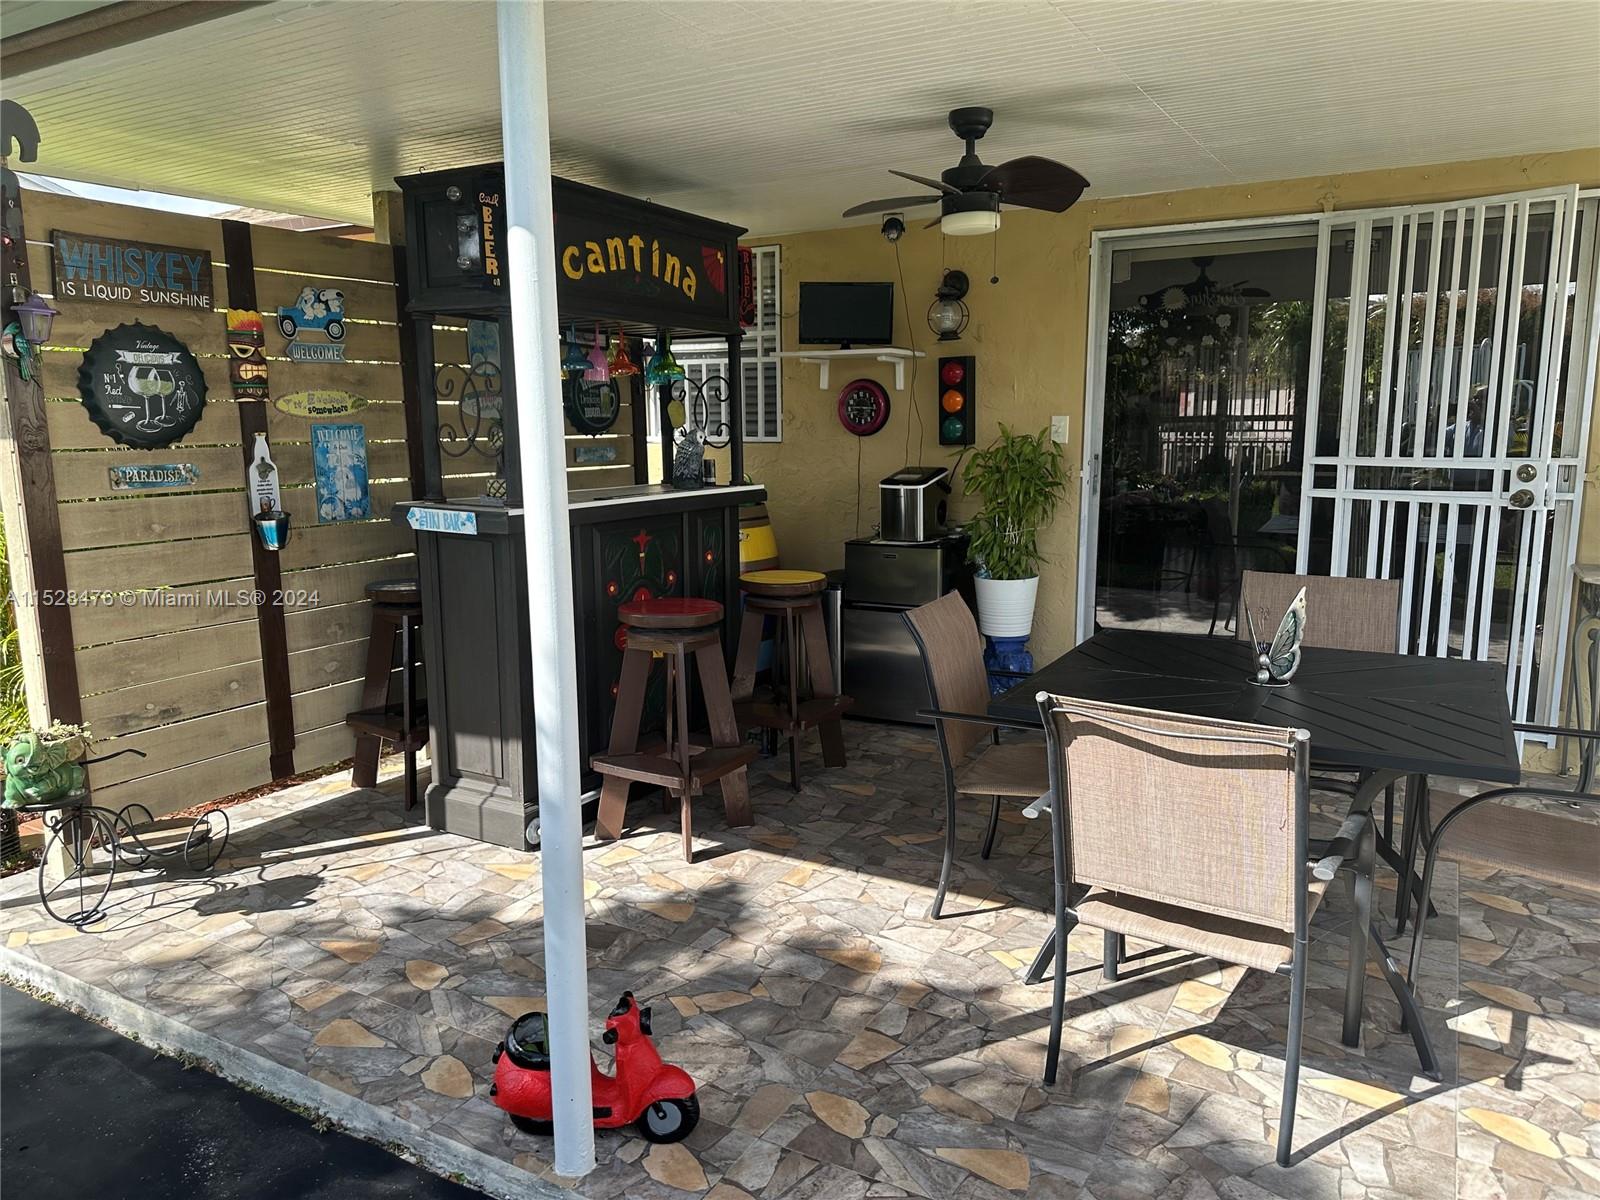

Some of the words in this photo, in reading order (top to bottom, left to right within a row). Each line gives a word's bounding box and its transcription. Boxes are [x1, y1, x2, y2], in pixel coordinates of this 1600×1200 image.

[482, 206, 499, 275] BEER
[59, 238, 203, 291] WHISKEY
[562, 235, 697, 301] cantina
[61, 281, 76, 296] IS
[83, 283, 132, 300] LIQUID
[140, 289, 210, 308] SUNSHINE
[136, 340, 160, 352] Vintage
[292, 344, 341, 360] WELCOME
[104, 384, 123, 396] Red
[307, 404, 348, 414] somewhere
[317, 429, 359, 441] WELCOME
[125, 469, 181, 482] PARADISE
